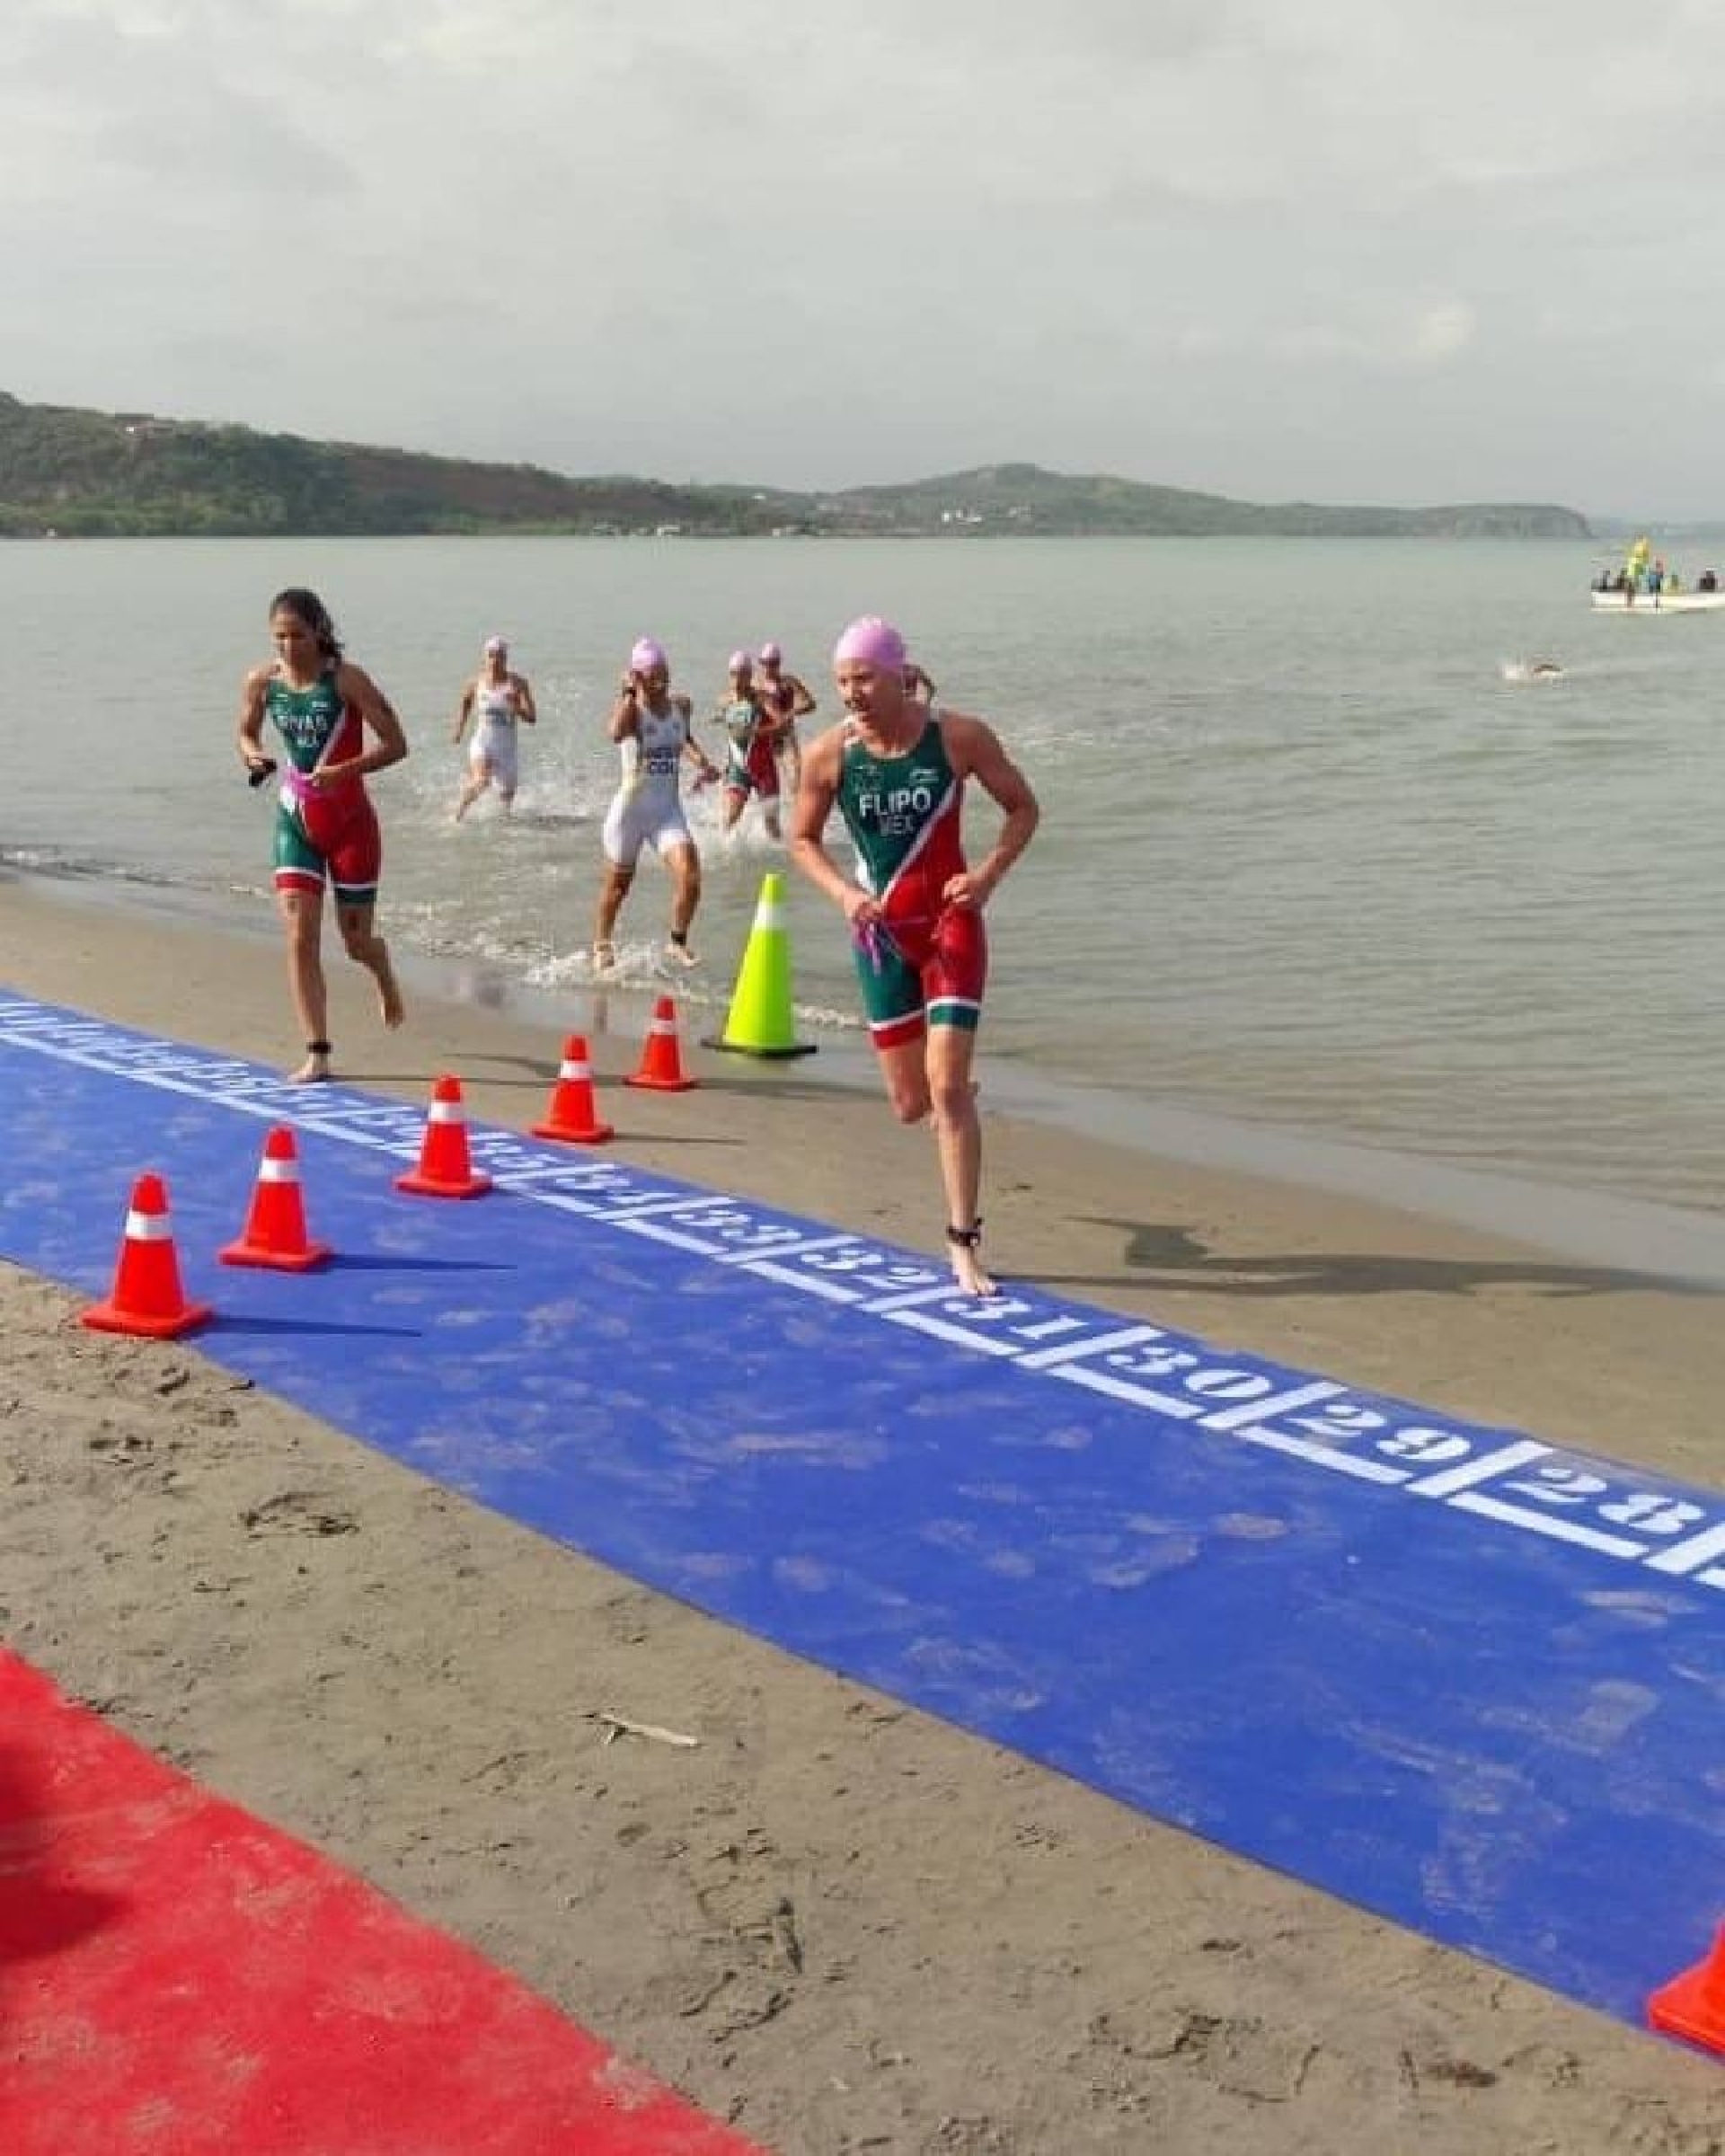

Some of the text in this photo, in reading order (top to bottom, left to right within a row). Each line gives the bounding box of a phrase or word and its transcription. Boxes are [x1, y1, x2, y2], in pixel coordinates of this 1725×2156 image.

[858, 786, 932, 818] FLIPO
[801, 1249, 939, 1291] 32
[944, 1296, 1090, 1339] 31
[1105, 1346, 1272, 1398] 30
[1282, 1403, 1472, 1461] 29
[1501, 1467, 1705, 1534] 28
